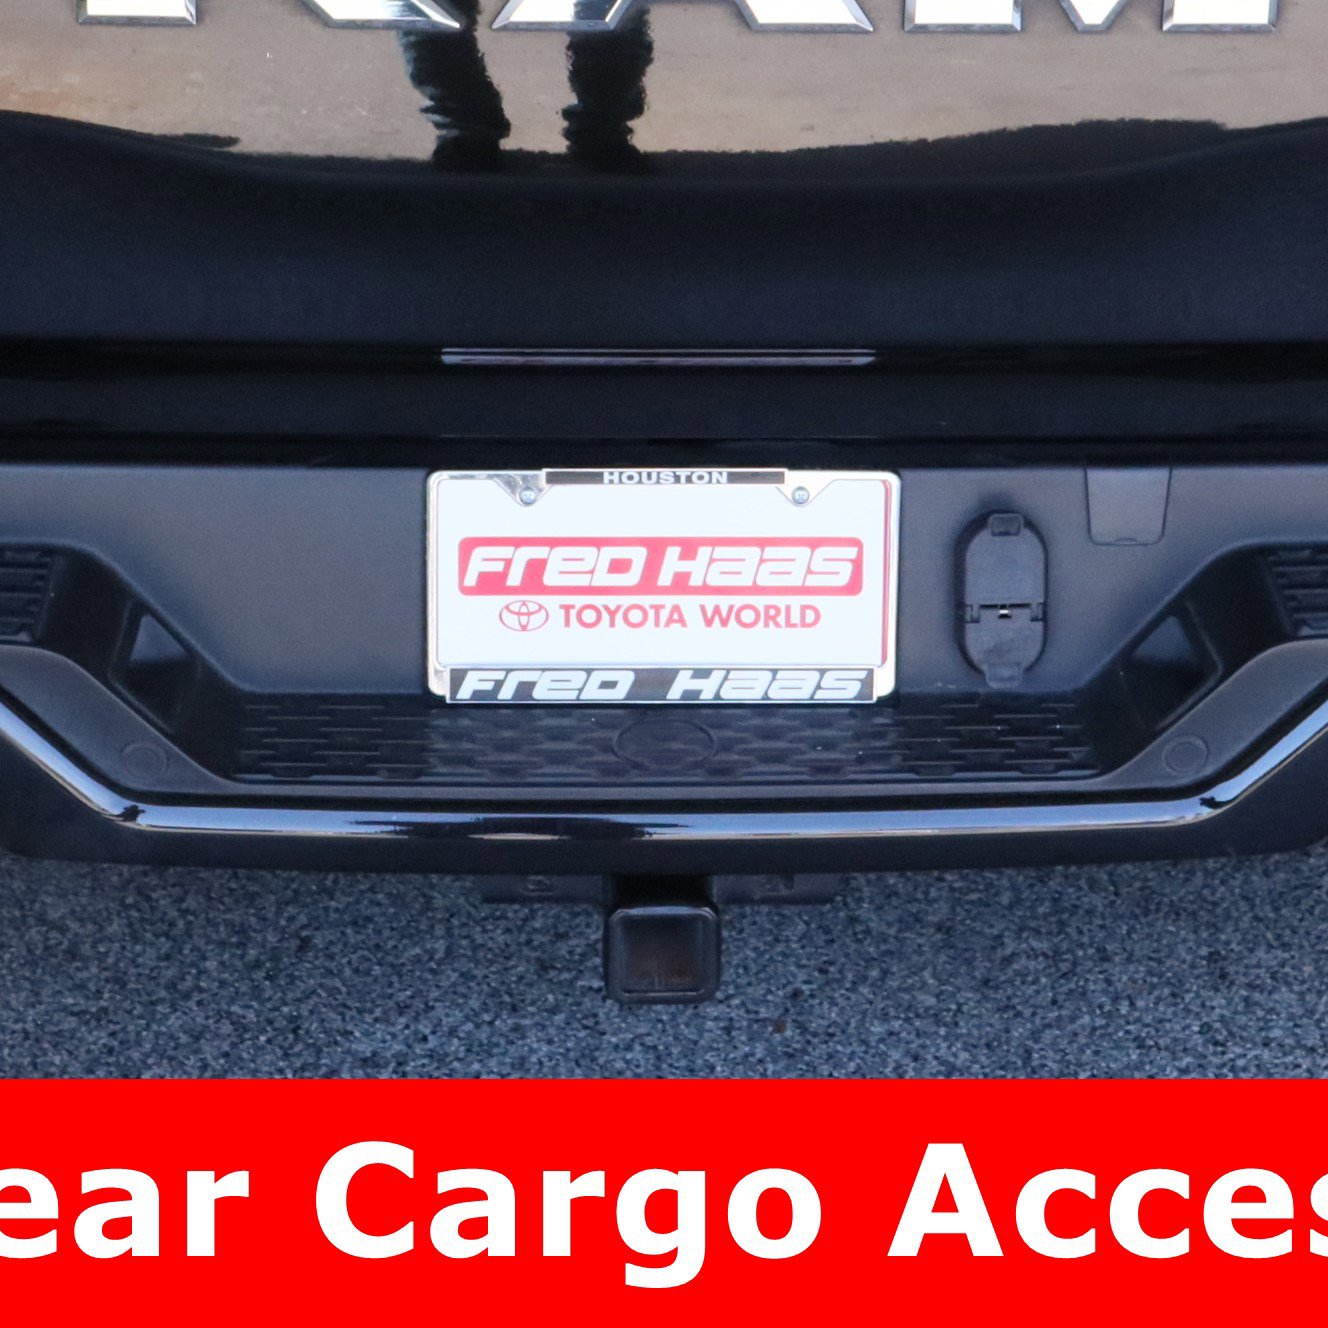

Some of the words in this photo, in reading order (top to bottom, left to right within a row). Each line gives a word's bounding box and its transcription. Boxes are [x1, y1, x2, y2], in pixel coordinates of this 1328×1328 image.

[602, 470, 729, 485] HOUSTON
[559, 603, 688, 629] TOYOTA
[700, 603, 822, 629] WORLD
